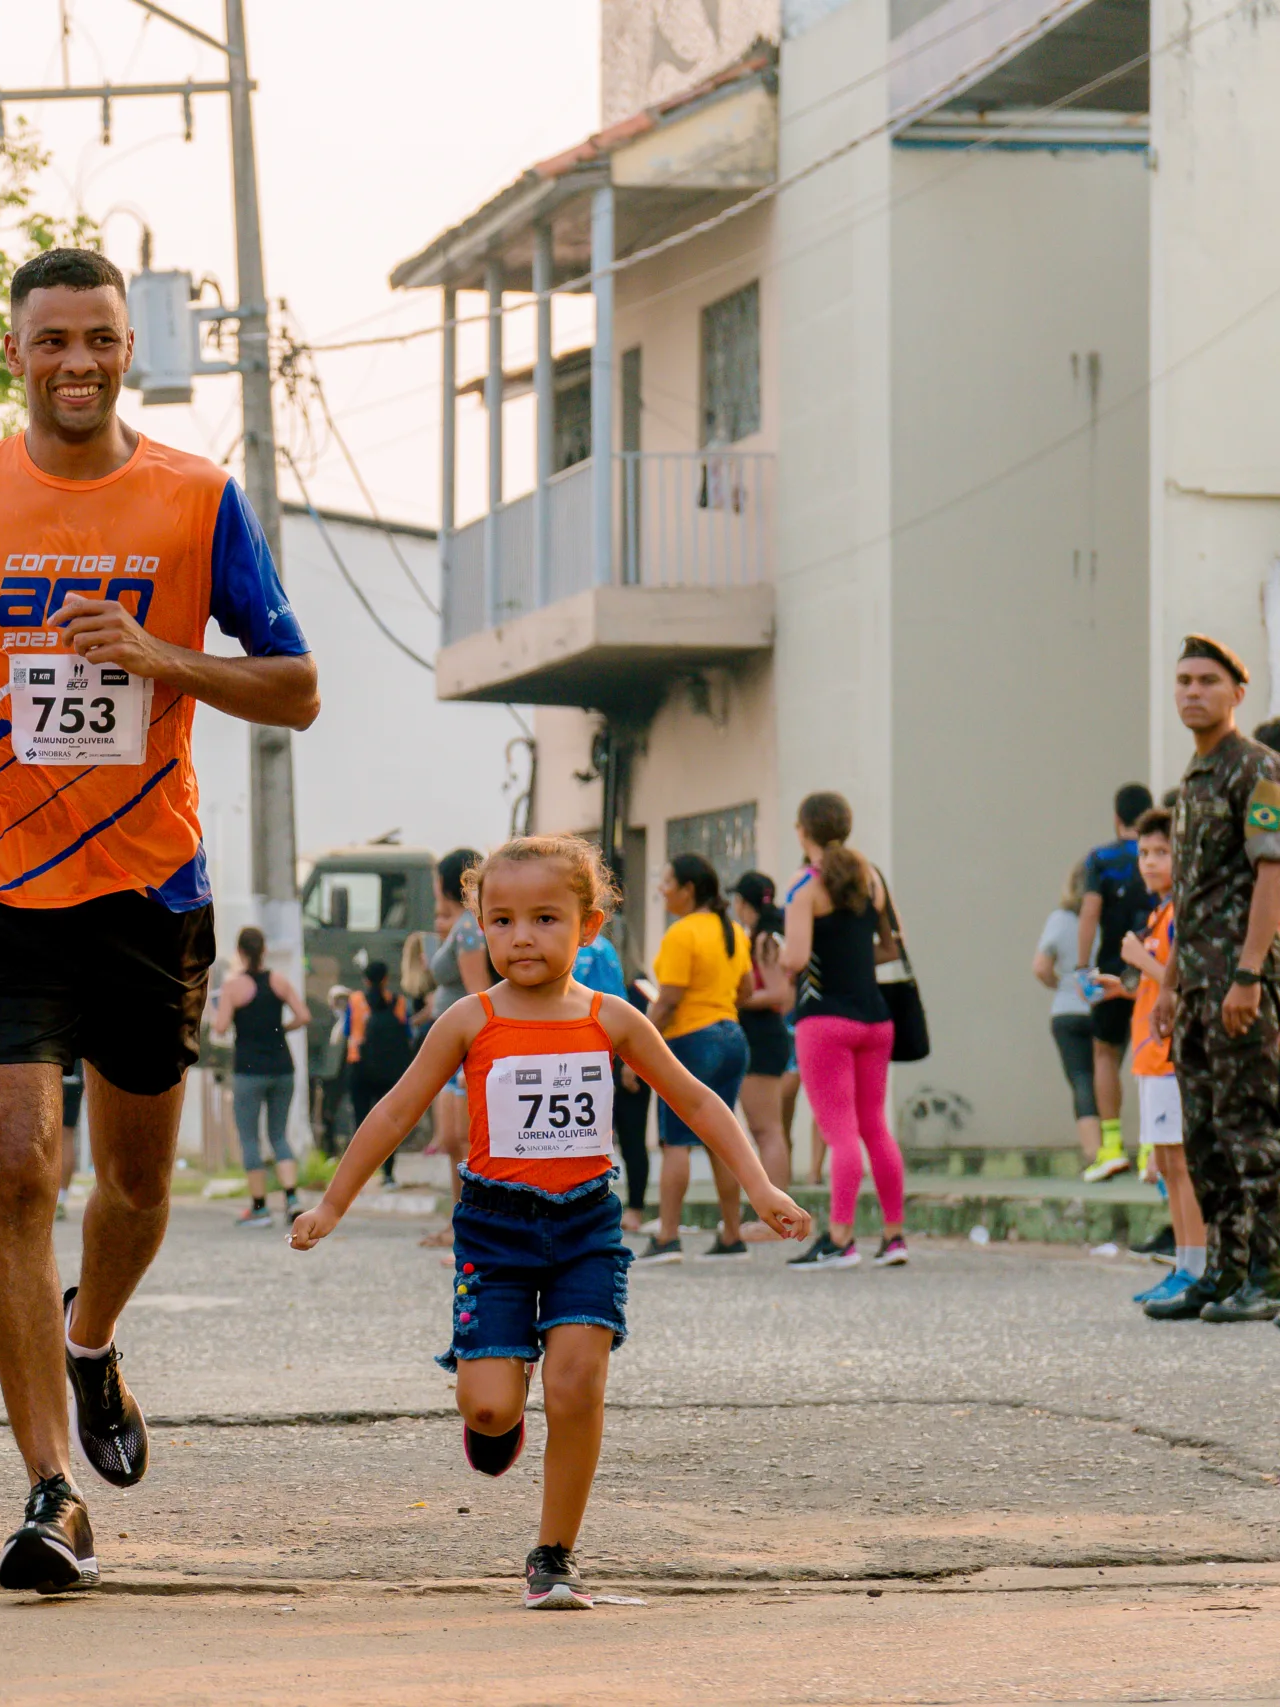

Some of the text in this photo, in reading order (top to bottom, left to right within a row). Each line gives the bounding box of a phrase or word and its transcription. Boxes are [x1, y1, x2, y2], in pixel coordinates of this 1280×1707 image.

[123, 554, 161, 573] DO
[2, 631, 59, 648] 2023
[32, 697, 116, 734] 753
[32, 736, 115, 745] RAIMUNDO OLIVEIRA
[37, 750, 72, 758] SINOBRAS
[518, 1092, 596, 1129] 753
[517, 1128, 598, 1140] LORENA OLIVEIRA
